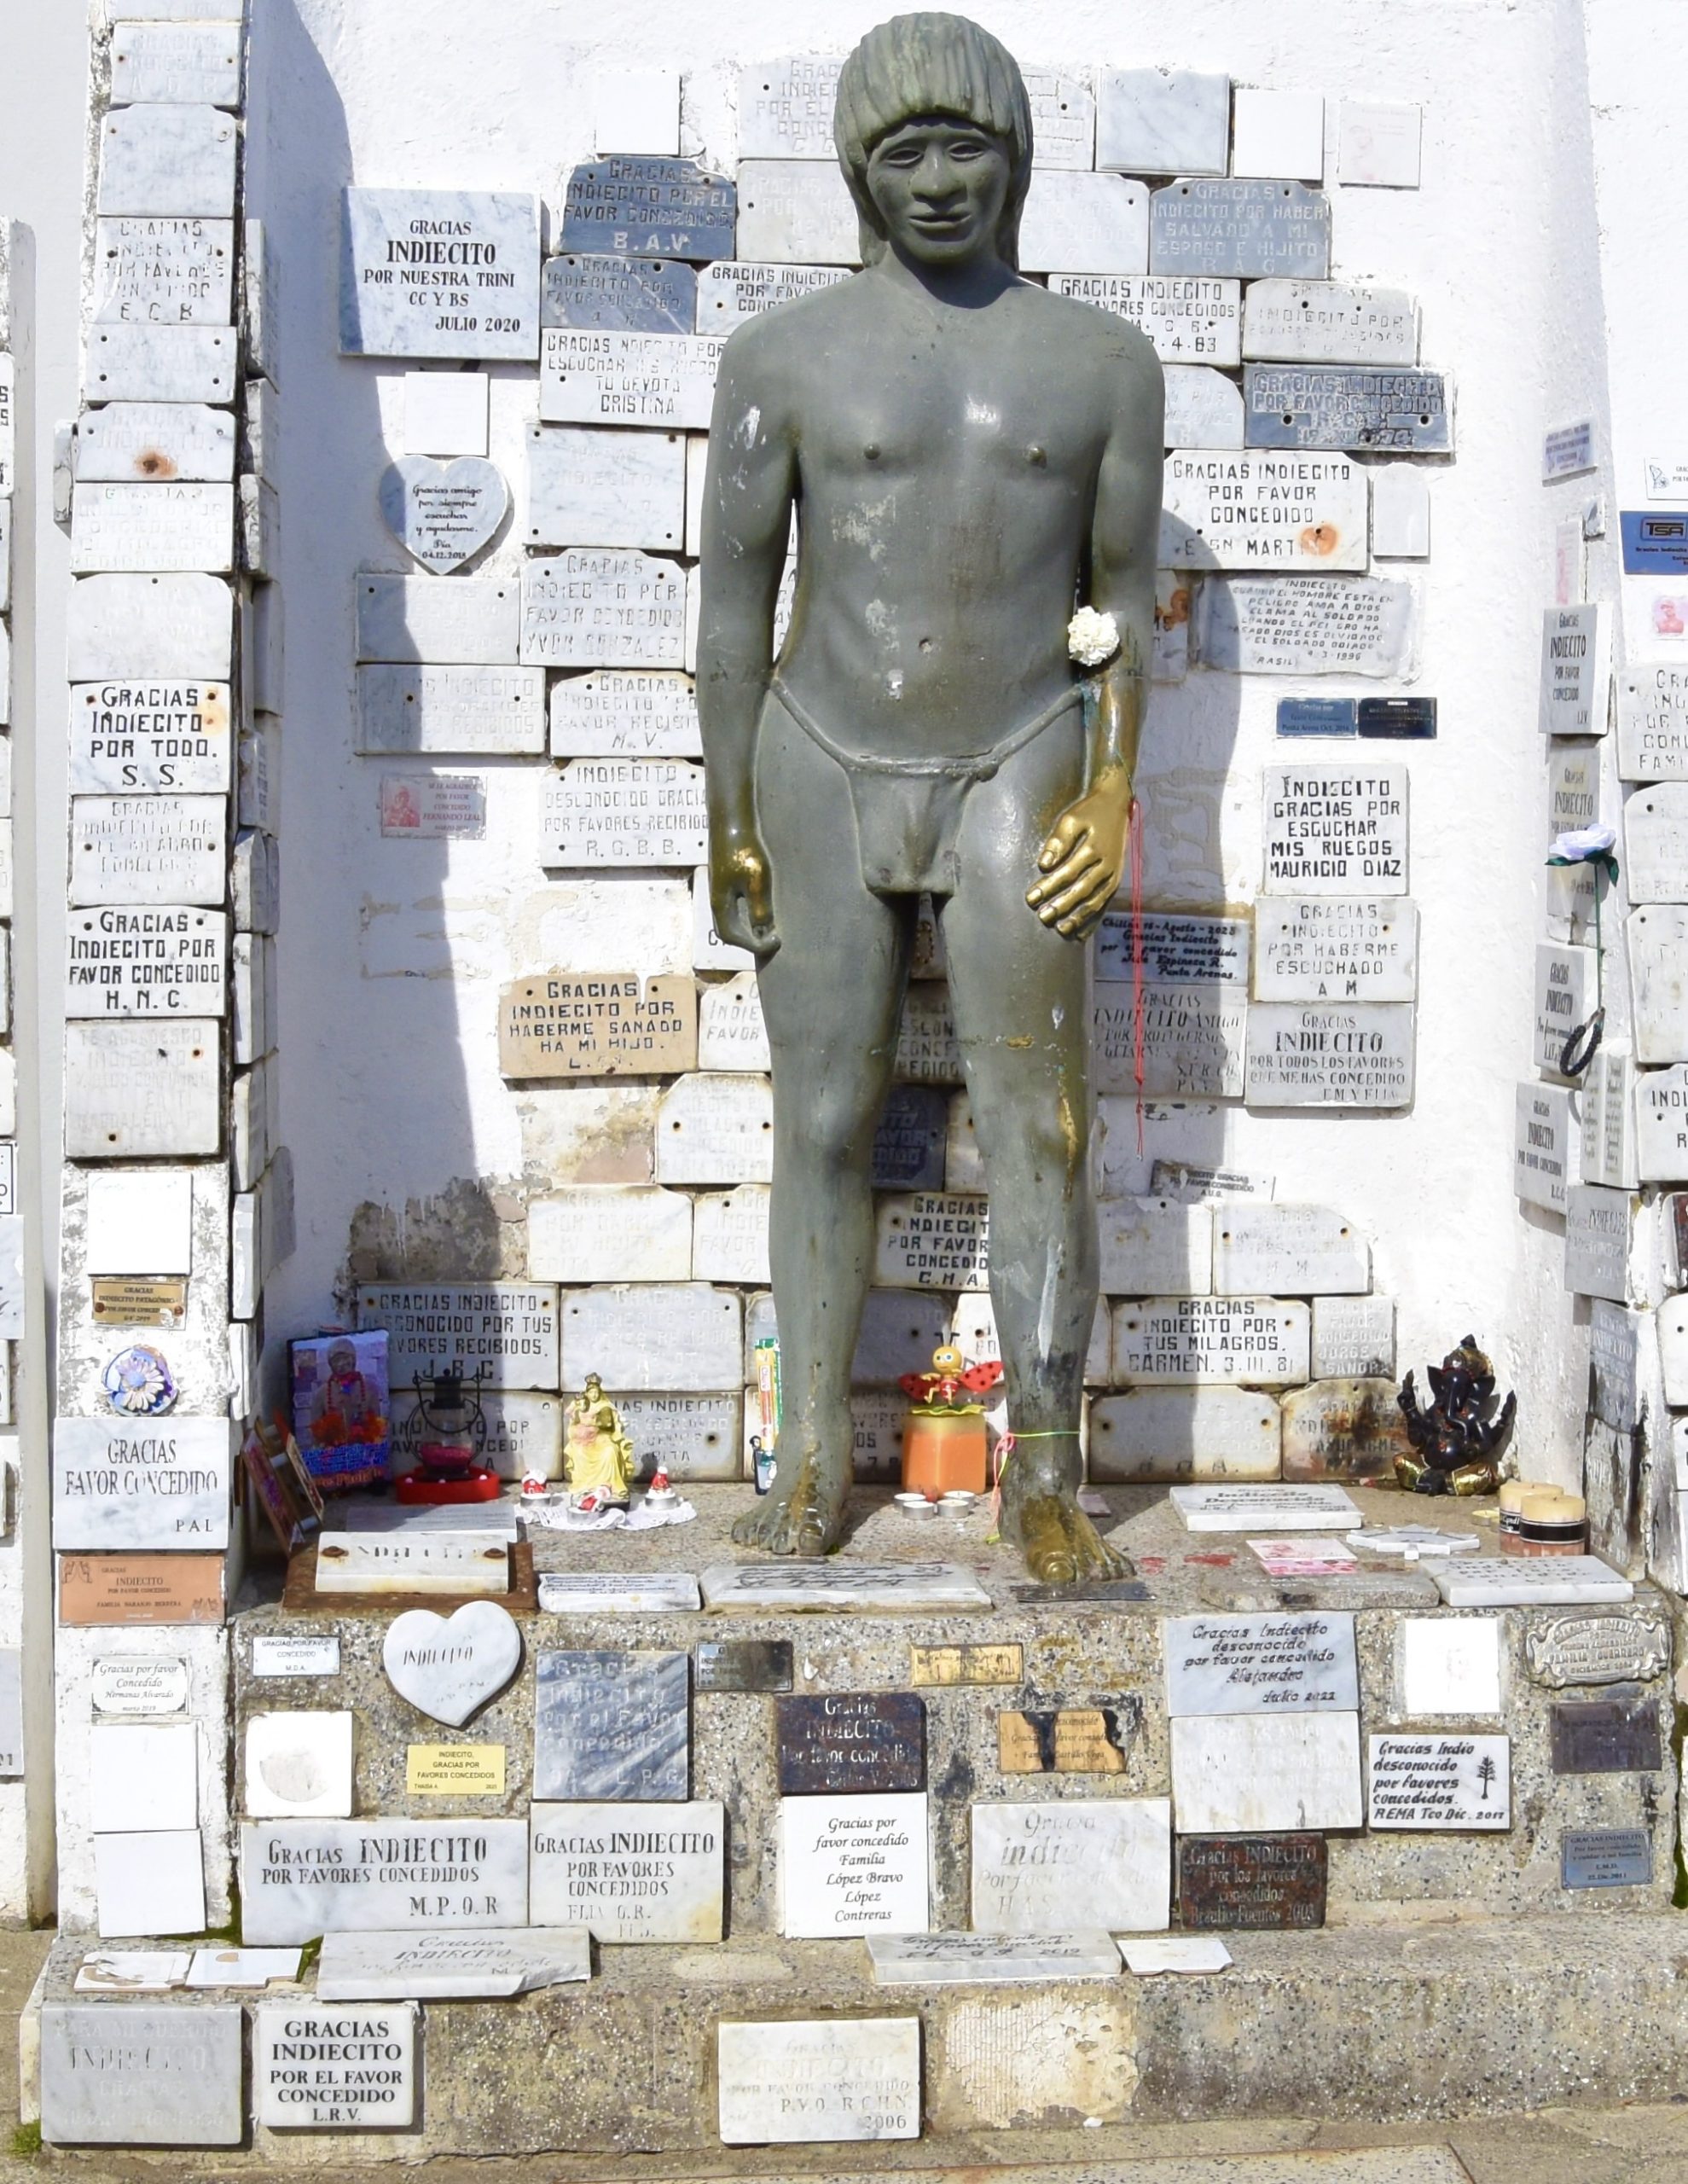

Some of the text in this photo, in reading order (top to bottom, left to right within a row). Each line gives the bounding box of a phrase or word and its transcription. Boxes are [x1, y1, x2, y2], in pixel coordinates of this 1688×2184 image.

[608, 160, 691, 183] GRACIAS
[1195, 182, 1275, 200] GRACIAS
[1153, 200, 1324, 221] INDIECITO POR HABER
[410, 219, 473, 235] GRACIAS
[386, 240, 496, 265] INDIECITO
[583, 258, 648, 275] GRACIAS
[363, 269, 515, 288] POR NUESTRA TRINI
[1060, 279, 1222, 300] GRACIAS INDIECITO
[435, 317, 521, 333] JULIO 2020
[548, 357, 625, 373] ESCUCHAR
[1254, 374, 1445, 396] GRACIAS INDIECITO
[600, 394, 676, 415] CRISTINA
[1253, 393, 1444, 415] POR FAVOR CONCEDIDO
[1173, 461, 1351, 480] GRACIAS INDIECITO
[1209, 485, 1317, 501] POR FAVOR
[1210, 507, 1314, 523] CONCEDIDO
[567, 558, 643, 574] GRACIAS
[1558, 612, 1580, 630] GRACIAS
[1549, 635, 1586, 659] INDIECITO
[600, 674, 679, 692] GRACIAS
[102, 686, 199, 707] GRACIAS
[91, 713, 203, 733] INDIECITO
[90, 739, 218, 758] POR TODO.
[577, 765, 677, 783] INDIECITO
[1281, 775, 1390, 797] INDIECITO
[1273, 800, 1401, 818] GRACIAS POR
[1288, 821, 1378, 838] ESCUCHAR
[1271, 840, 1393, 857] MIS RUEGOS
[1270, 859, 1402, 878] MAURICIO DIAZ
[100, 910, 189, 932] GRACIAS
[1300, 904, 1378, 920] GRACIAS
[1291, 923, 1378, 938] INDIECITO
[69, 936, 215, 959] INDIECITO POR
[1267, 943, 1399, 957] POR HABERME
[69, 964, 220, 985] FAVOR CONCEDIDO
[1157, 965, 1190, 977] Punta
[1276, 960, 1383, 975] ESCUCHADO
[1549, 961, 1570, 985] GRACIAS
[547, 981, 638, 999] GRACIAS
[512, 1001, 675, 1020] INDIECITO POR
[1545, 989, 1574, 1017] INDIECITO
[509, 1019, 682, 1037] HABERME SANADO
[1302, 1012, 1357, 1029] GRACIAS
[540, 1035, 664, 1053] HA MI HIJO.
[1275, 1031, 1383, 1053] INDIECITO
[1250, 1055, 1405, 1069] POR TODOS LOS FAVORES
[1528, 1121, 1555, 1151] INDIECITO
[914, 1196, 989, 1216] GRACIAS
[887, 1235, 989, 1253] POR FAVOR
[380, 1294, 537, 1311] GRACIAS INDIECITO
[1178, 1301, 1256, 1316] GRACIAS
[1143, 1319, 1277, 1334] INDIECITO POR
[1143, 1336, 1287, 1351] TUS MILAGROS.
[107, 1438, 177, 1465] GRACIAS
[65, 1469, 218, 1496] FAVOR CONCEDIDO
[115, 1577, 164, 1586] INDIECITO
[1192, 1623, 1328, 1639] Gracias Indiecito
[1211, 1637, 1307, 1653] desconocido
[1183, 1650, 1335, 1670] por favor concedido
[100, 1664, 178, 1676] Gracias por favor
[1226, 1667, 1304, 1684] Alejandro
[116, 1678, 163, 1688] Concedido
[1378, 1741, 1475, 1756] Gracias Indio
[1373, 1757, 1459, 1772] desconocido
[1373, 1776, 1459, 1792] por favores
[1373, 1791, 1459, 1805] concedidos.
[828, 1817, 897, 1830] Gracias por
[534, 1833, 715, 1855] GRACIAS INDIECITO
[813, 1833, 909, 1852] favor concedido
[1570, 1835, 1604, 1844] GRACIAS
[269, 1838, 488, 1865] GRACIAS INDIECITO
[839, 1853, 885, 1867] Familia
[1190, 1844, 1317, 1866] Gracias INDIECITO
[262, 1867, 480, 1885] POR FAVORES CONCEDIDOS
[567, 1861, 675, 1878] POR FAVORES
[827, 1871, 903, 1885] López Bravo
[568, 1881, 670, 1896] CONCEDIDOS
[844, 1890, 881, 1904] López
[834, 1909, 892, 1923] Contreras
[284, 2020, 390, 2038] GRACIAS
[272, 2043, 403, 2061] INDIECITO
[270, 2071, 403, 2085] POR EL FAVOR
[277, 2088, 396, 2104] CONCEDIDO
[312, 2107, 362, 2123] L.R.V.
[864, 2115, 908, 2130] 2006
